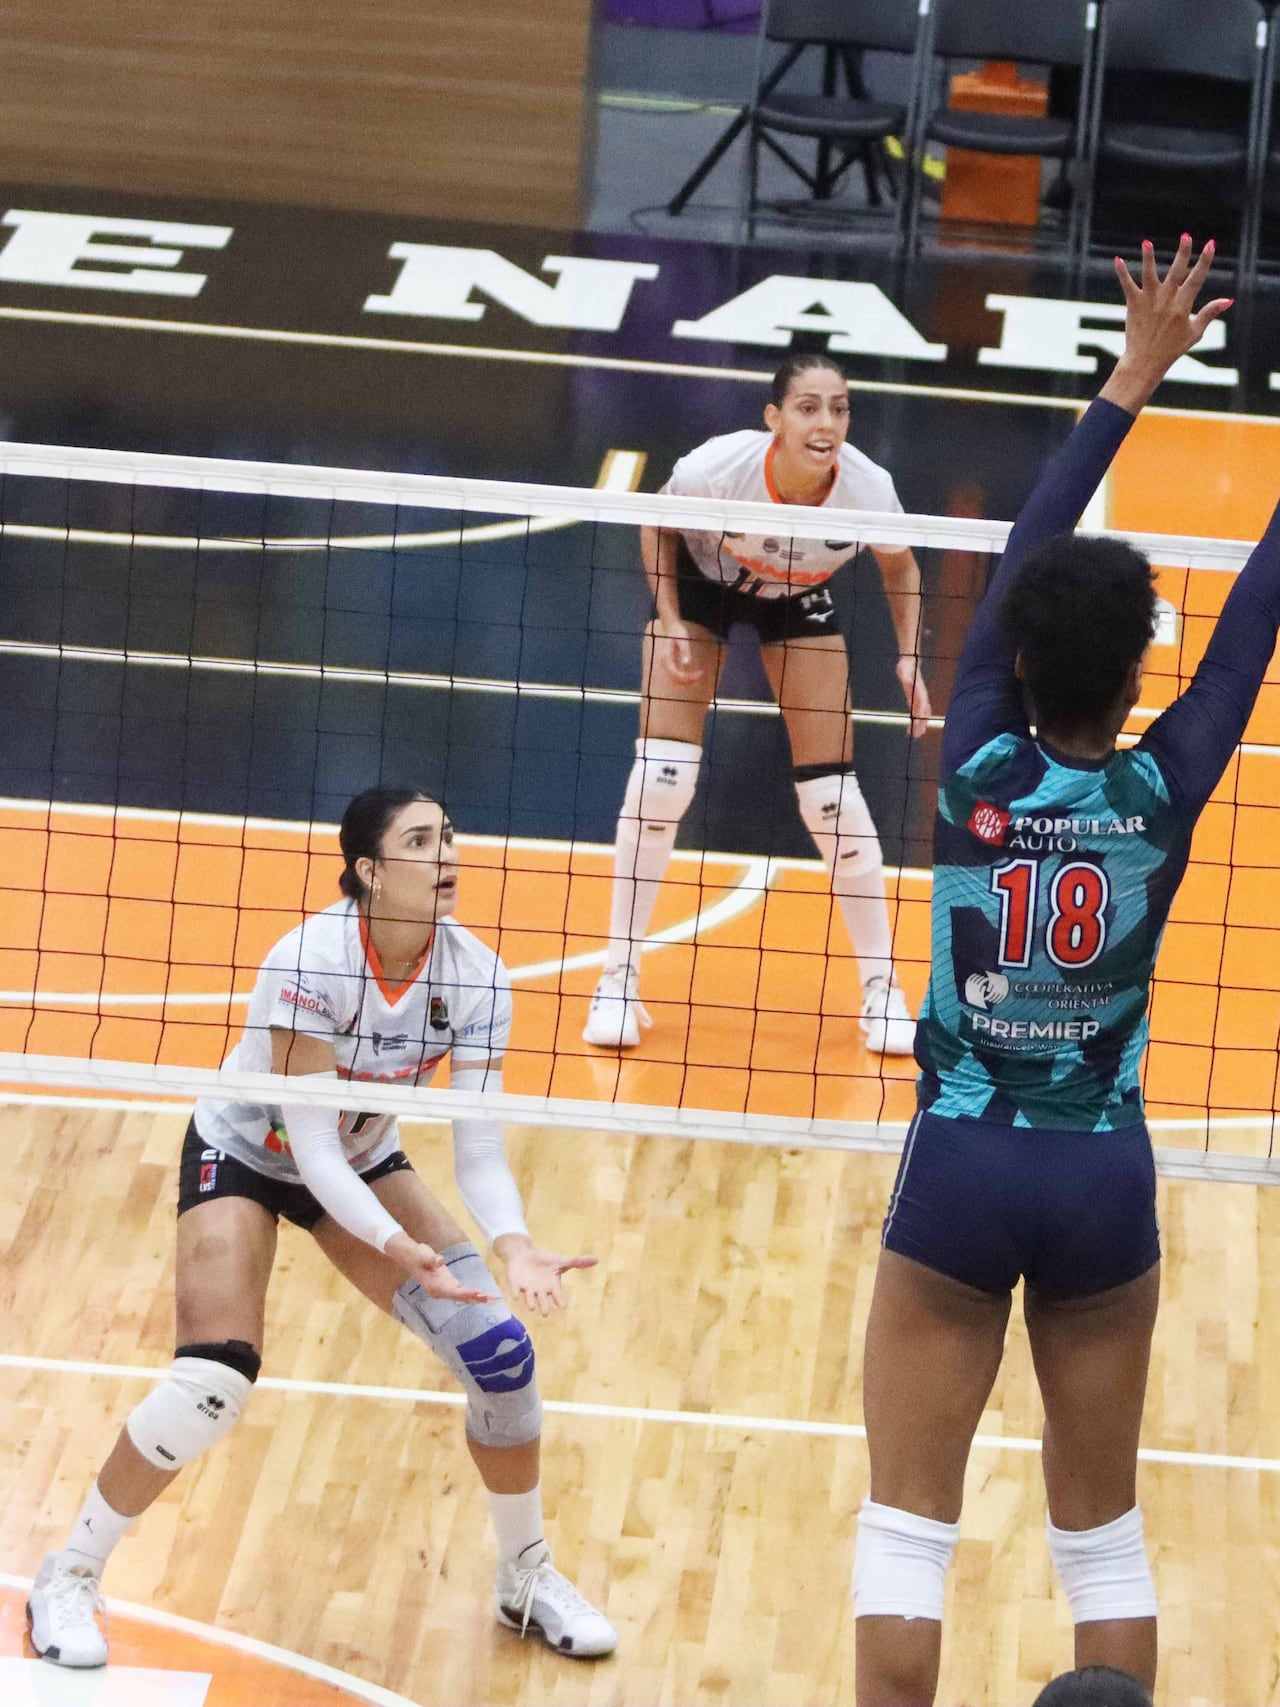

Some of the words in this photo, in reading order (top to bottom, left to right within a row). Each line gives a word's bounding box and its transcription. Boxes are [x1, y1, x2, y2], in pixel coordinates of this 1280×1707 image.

[1014, 815, 1147, 836] POPULAR
[1009, 835, 1077, 852] AUTO
[991, 858, 1109, 969] 18
[1014, 981, 1113, 994] COOPERATIVA
[1048, 996, 1111, 1009] ORIENTAL
[972, 1013, 1100, 1041] PREMIER
